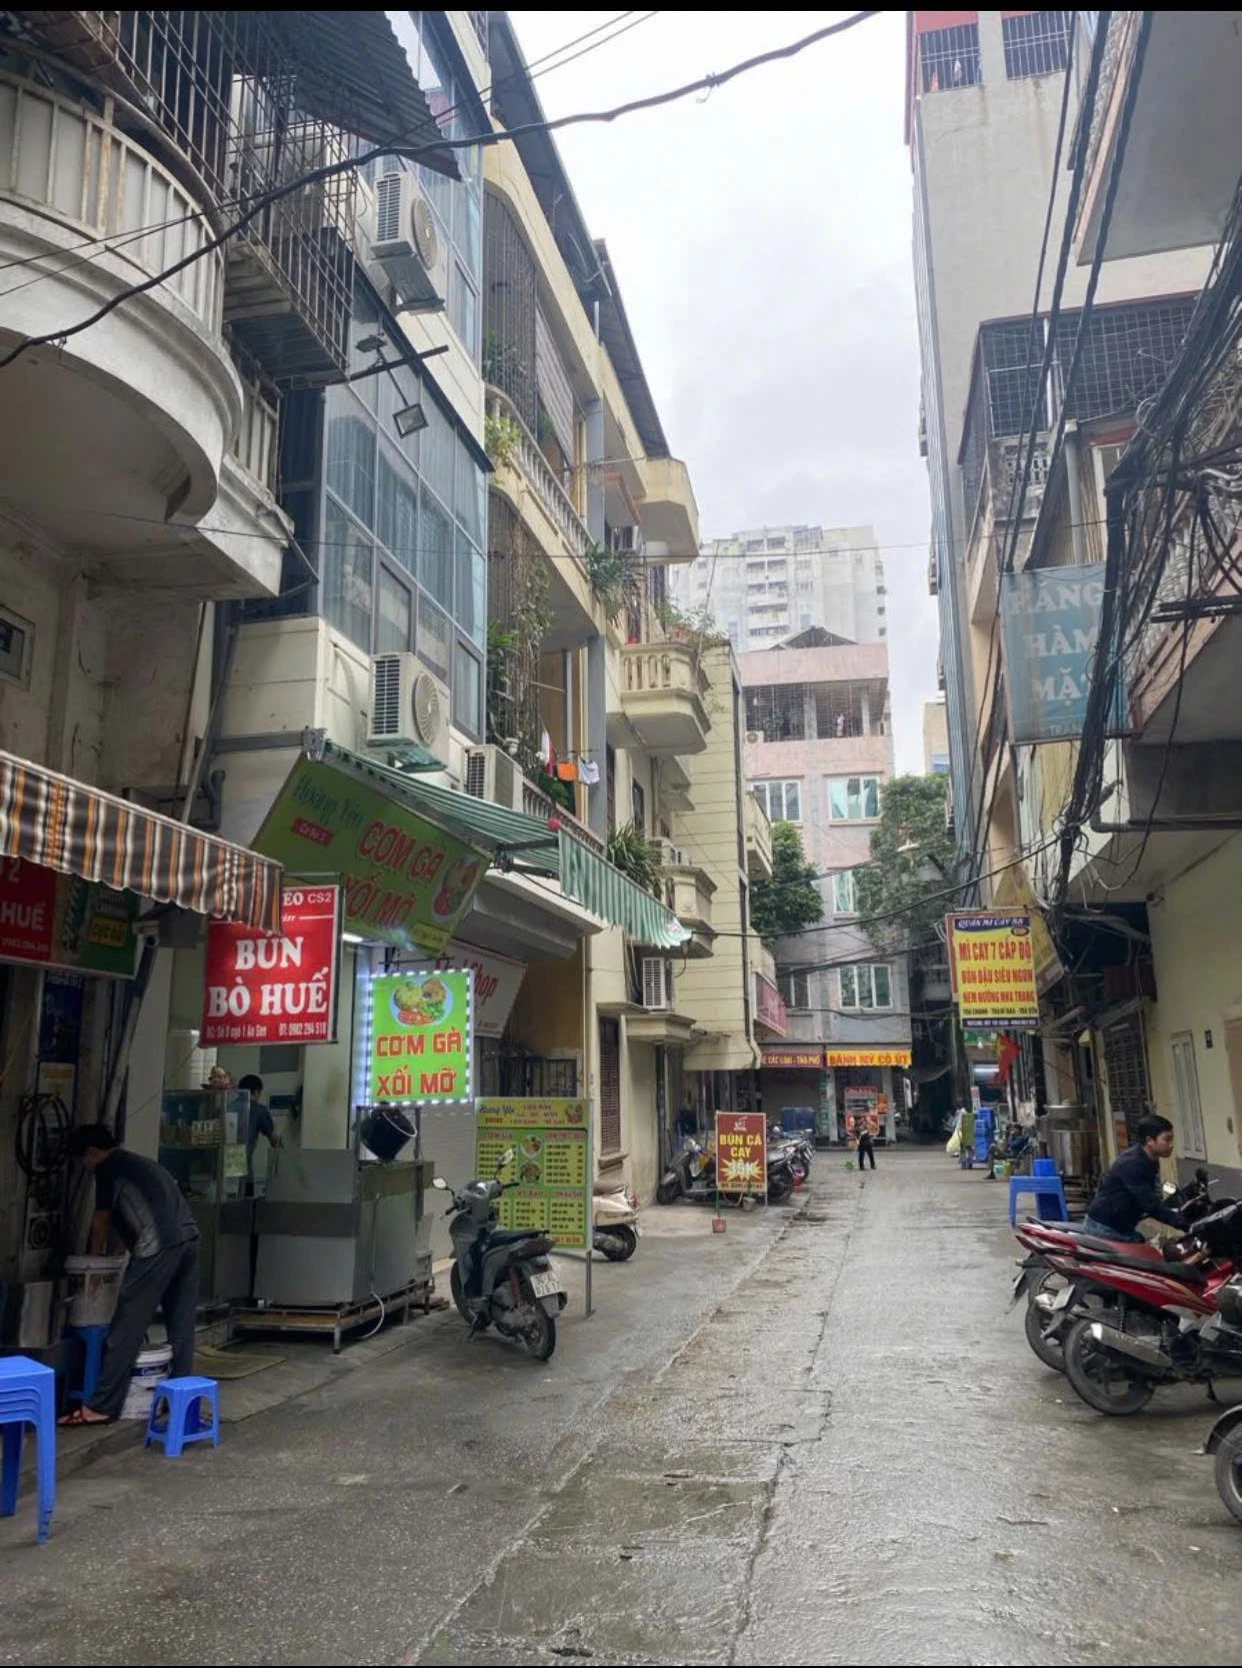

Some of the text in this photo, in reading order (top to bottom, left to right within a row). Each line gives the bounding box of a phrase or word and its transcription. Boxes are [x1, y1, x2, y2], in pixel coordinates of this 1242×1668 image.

[1033, 667, 1095, 706] MẶ
[308, 891, 332, 904] CS2
[959, 936, 1032, 964] MÌ CAY 7 CẤP ĐỘ
[208, 966, 329, 1017] BÒ HUẾ
[376, 1026, 463, 1057] CƠM GÀ
[829, 1053, 857, 1065] BÁNH
[376, 1065, 457, 1097] XỐI MỠ
[720, 1132, 744, 1146] BÚN
[730, 1146, 752, 1158] CAY
